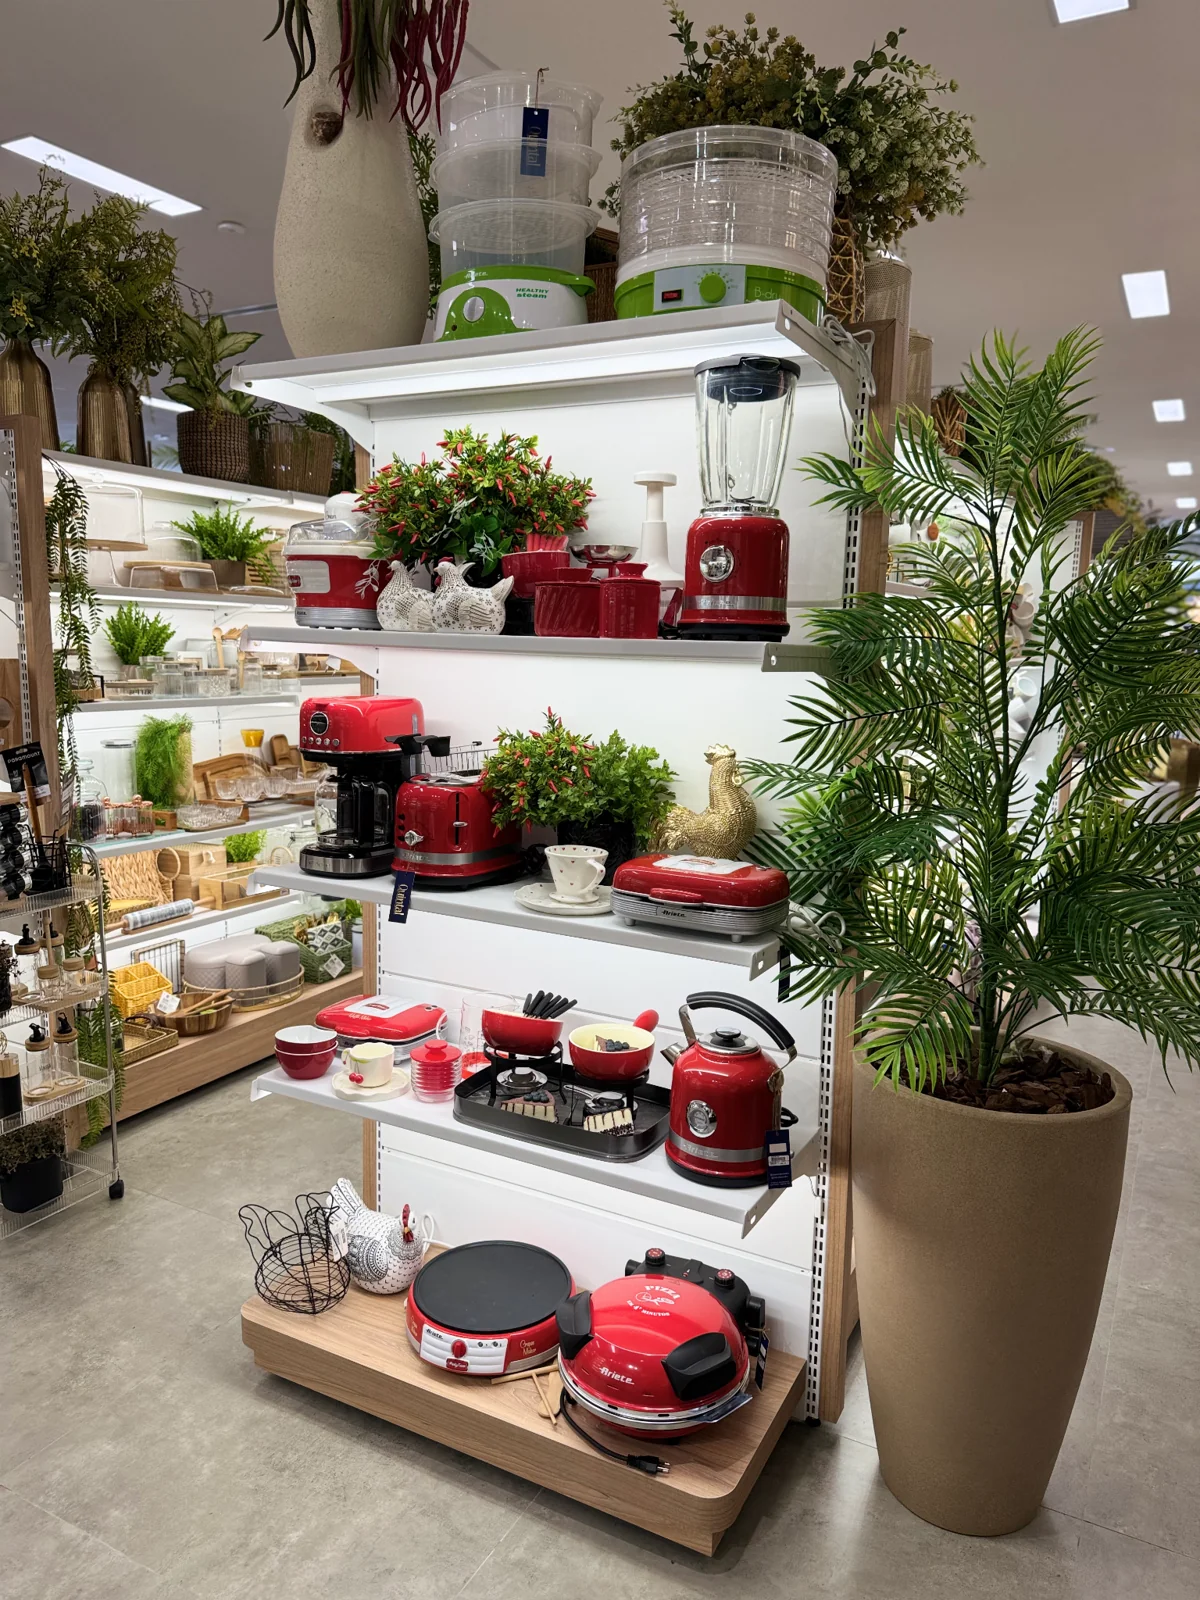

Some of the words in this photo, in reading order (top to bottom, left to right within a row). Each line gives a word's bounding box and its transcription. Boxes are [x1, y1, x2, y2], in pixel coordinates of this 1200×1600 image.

[394, 884, 409, 916] Quintal
[662, 910, 687, 918] Ariete
[644, 1285, 681, 1300] PIZZA
[426, 1328, 444, 1340] Ariete
[599, 1366, 635, 1385] Ariete
